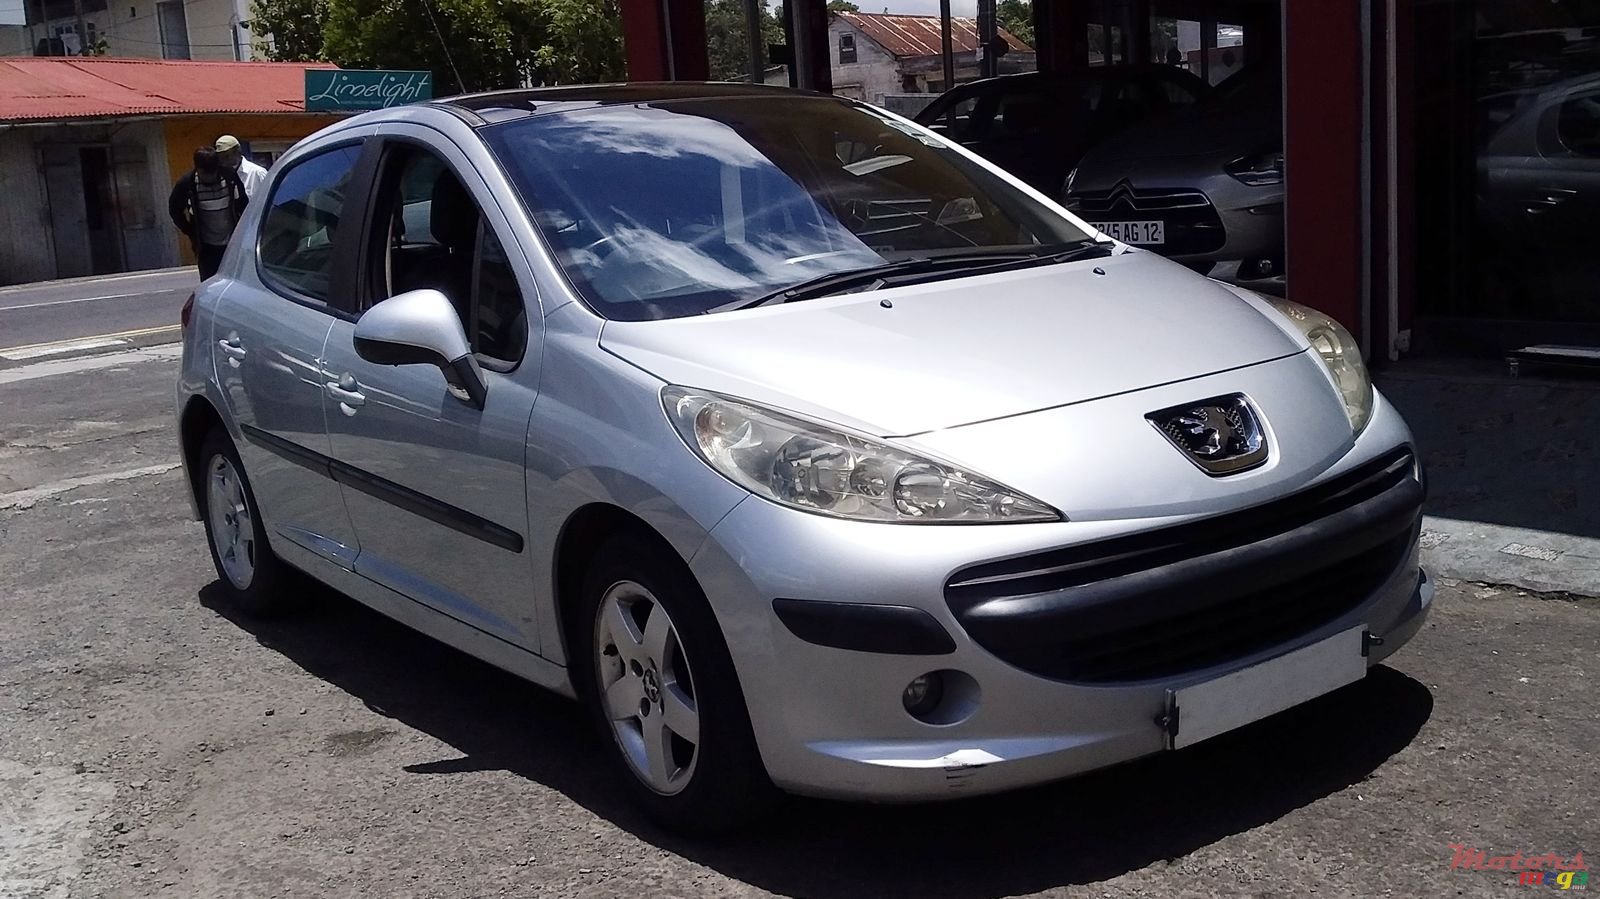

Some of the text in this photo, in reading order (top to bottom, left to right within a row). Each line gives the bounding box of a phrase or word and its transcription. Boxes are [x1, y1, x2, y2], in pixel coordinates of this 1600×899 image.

[309, 73, 429, 108] Limelight
[1092, 222, 1159, 241] 45 AG 12
